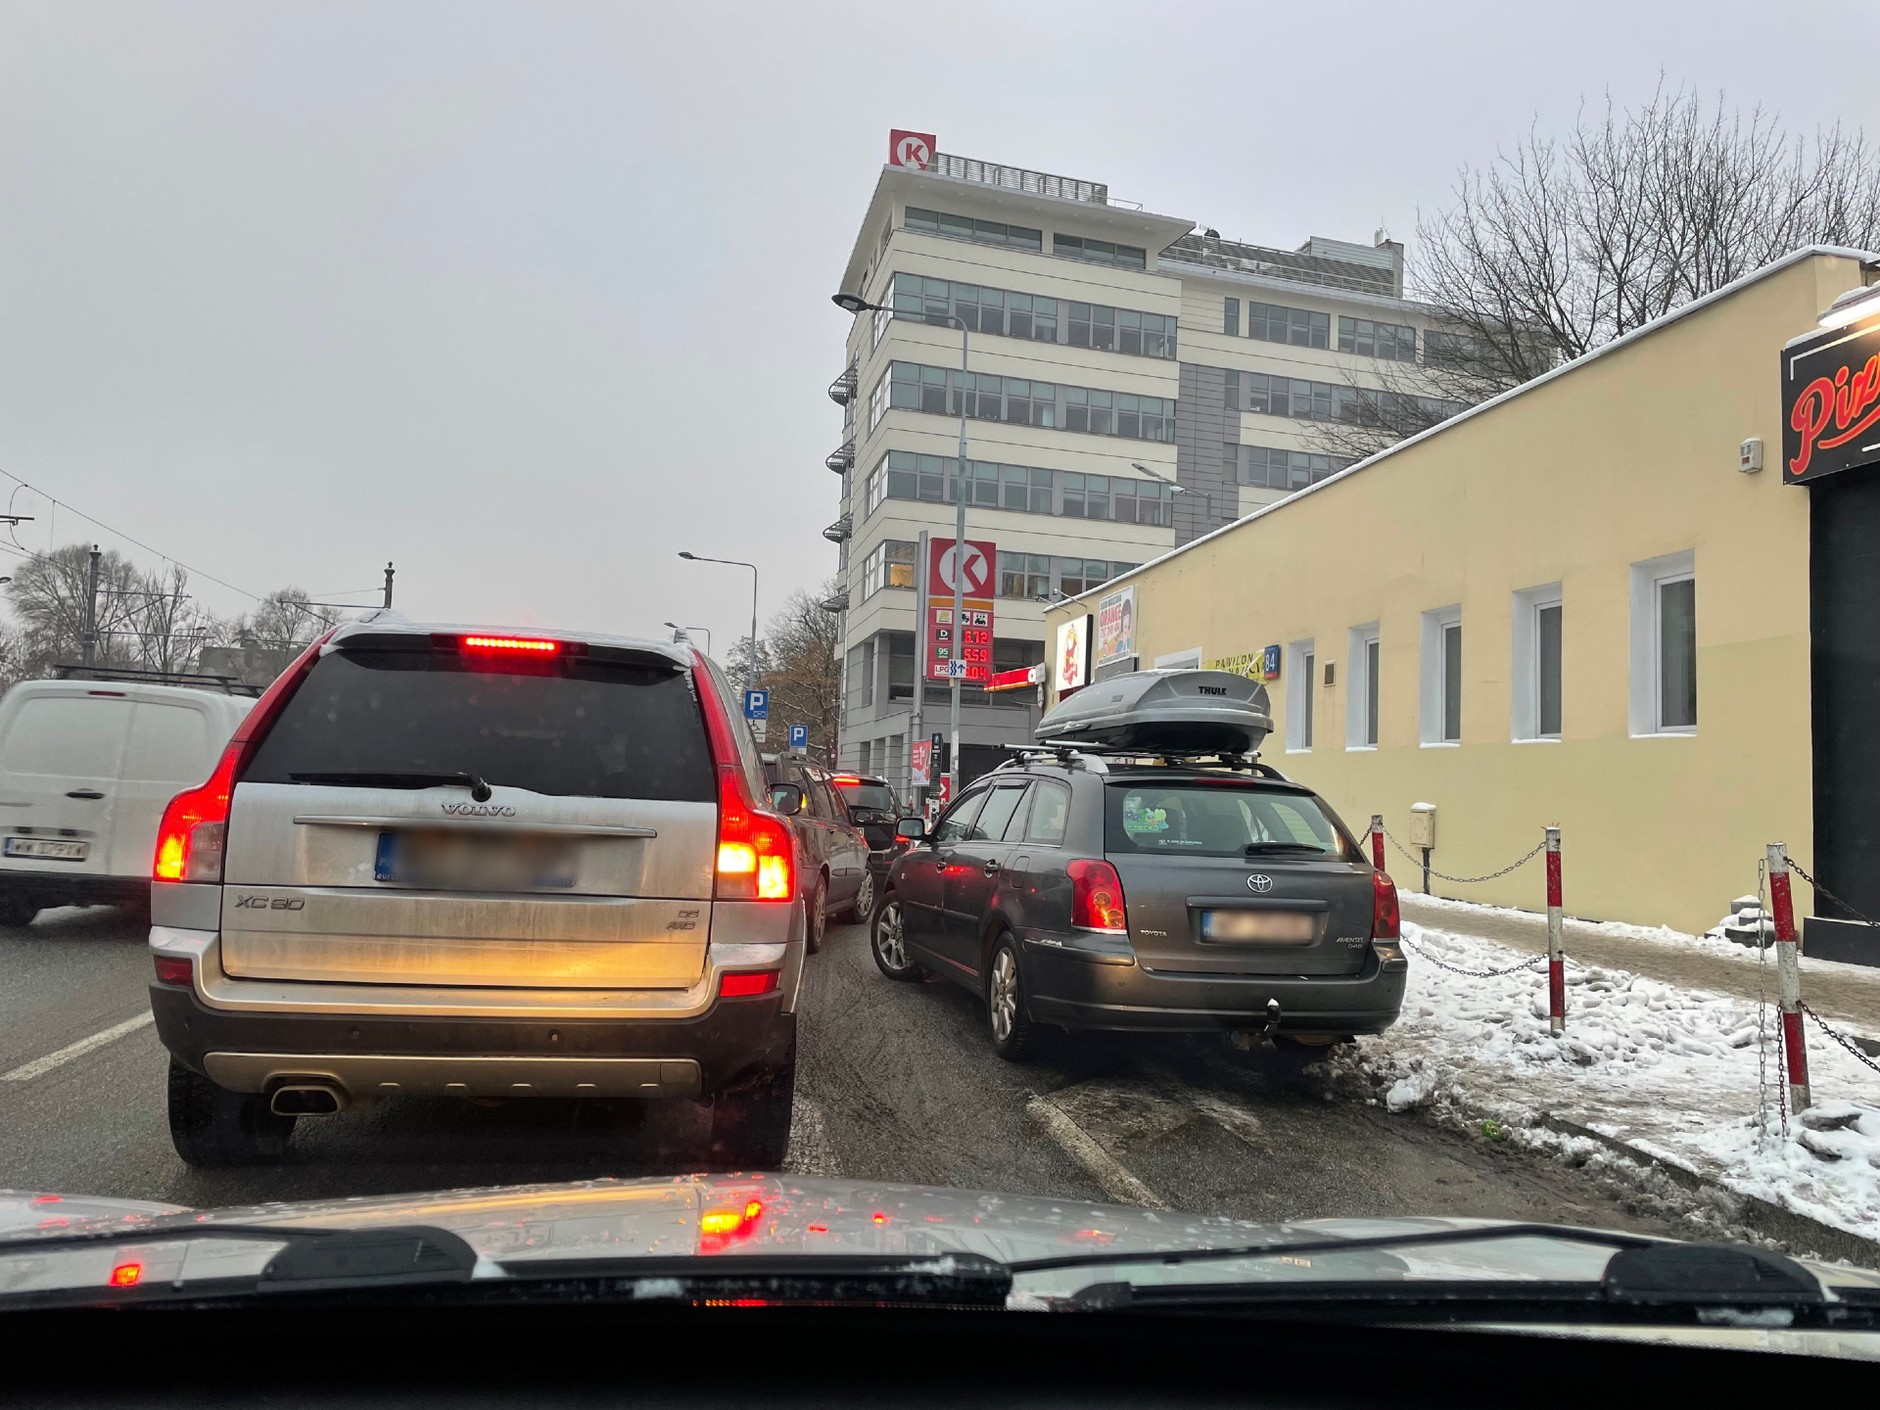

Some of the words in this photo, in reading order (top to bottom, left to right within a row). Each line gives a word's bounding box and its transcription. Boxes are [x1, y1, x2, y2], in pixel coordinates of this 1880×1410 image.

[905, 142, 927, 170] K
[952, 552, 985, 592] K
[940, 629, 948, 637] D
[964, 630, 988, 644] 6.72
[938, 647, 949, 655] 95
[1265, 653, 1276, 671] 84
[1198, 685, 1227, 696] THULE
[749, 692, 764, 711] P
[793, 727, 804, 741] P
[441, 802, 517, 817] VOLVO
[678, 910, 699, 919] D5
[666, 920, 696, 930] AWD
[1140, 929, 1168, 937] TOYOTA
